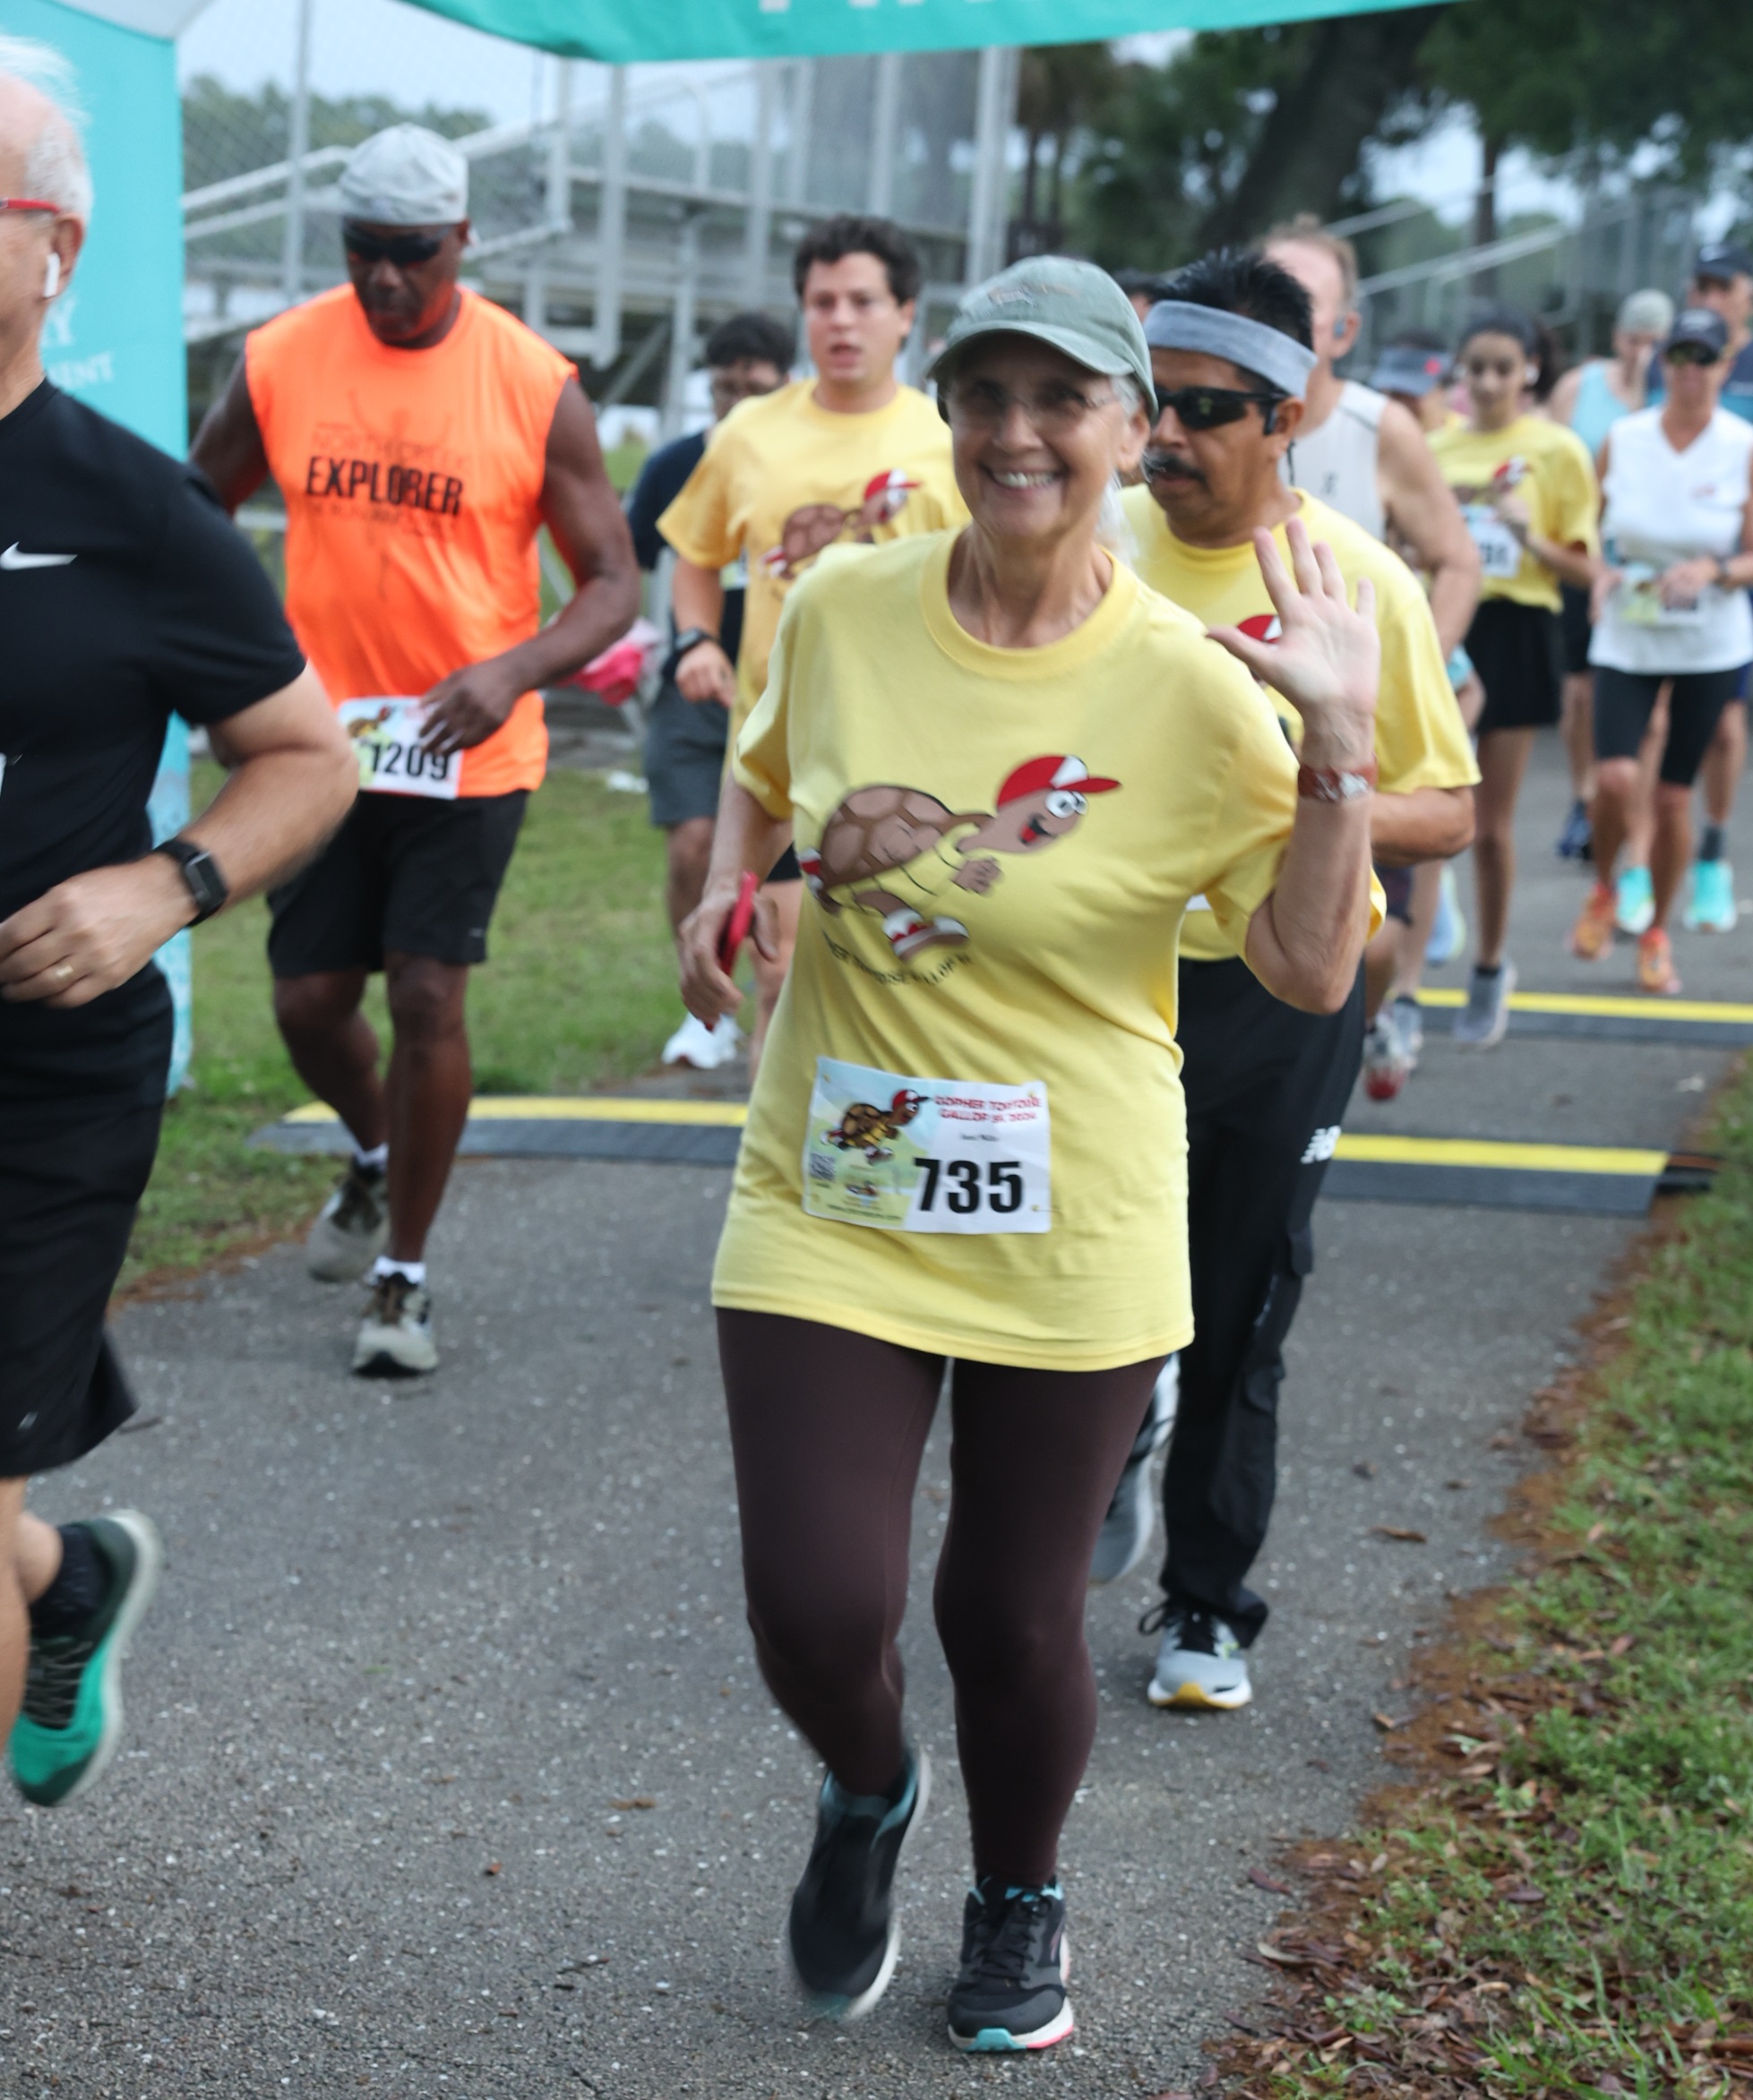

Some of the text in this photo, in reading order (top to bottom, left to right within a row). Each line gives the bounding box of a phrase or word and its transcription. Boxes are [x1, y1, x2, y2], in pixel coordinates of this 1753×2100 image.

[306, 456, 463, 516] EXPLORER
[370, 741, 449, 781] 1209
[914, 1157, 1023, 1213] 735
